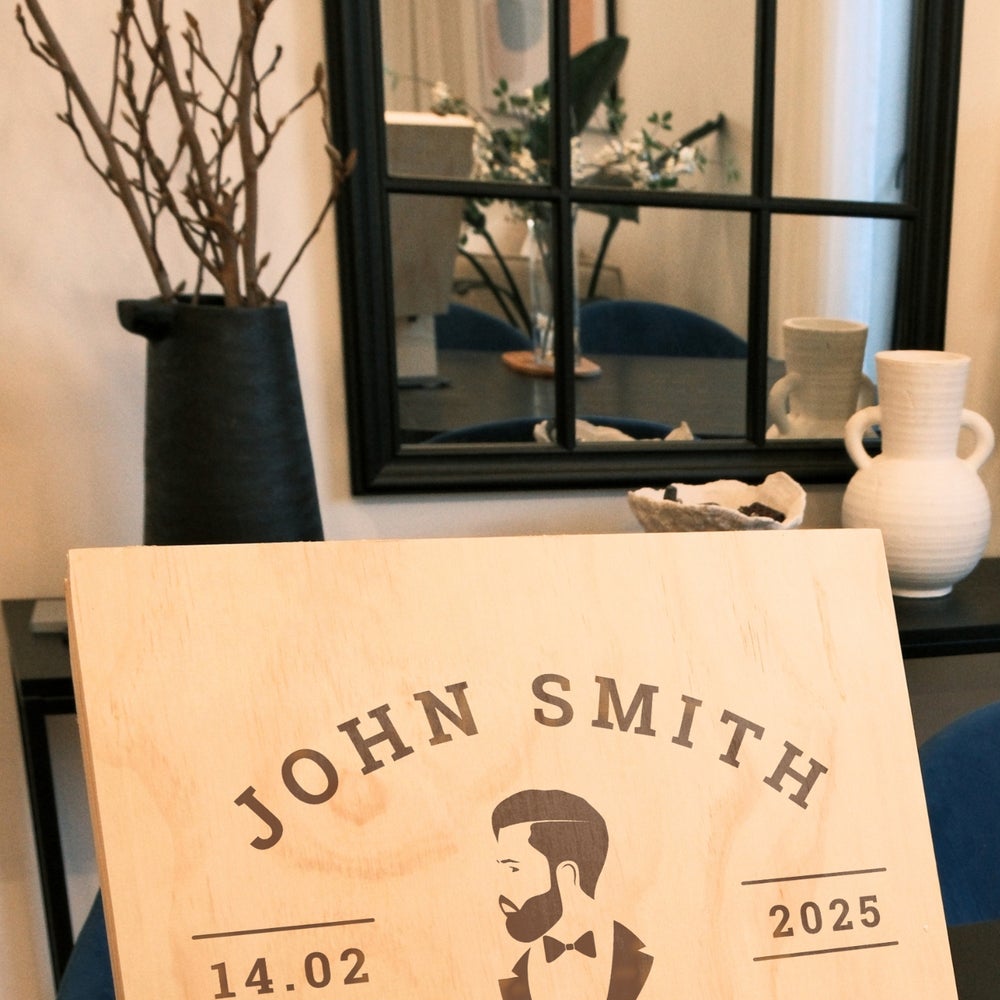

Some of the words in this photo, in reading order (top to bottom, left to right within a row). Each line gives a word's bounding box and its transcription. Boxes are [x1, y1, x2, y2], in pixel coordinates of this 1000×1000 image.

[233, 681, 479, 850] JOHN
[531, 673, 828, 810] SMITH
[768, 895, 882, 938] 2025
[210, 947, 370, 1000] 14.02
